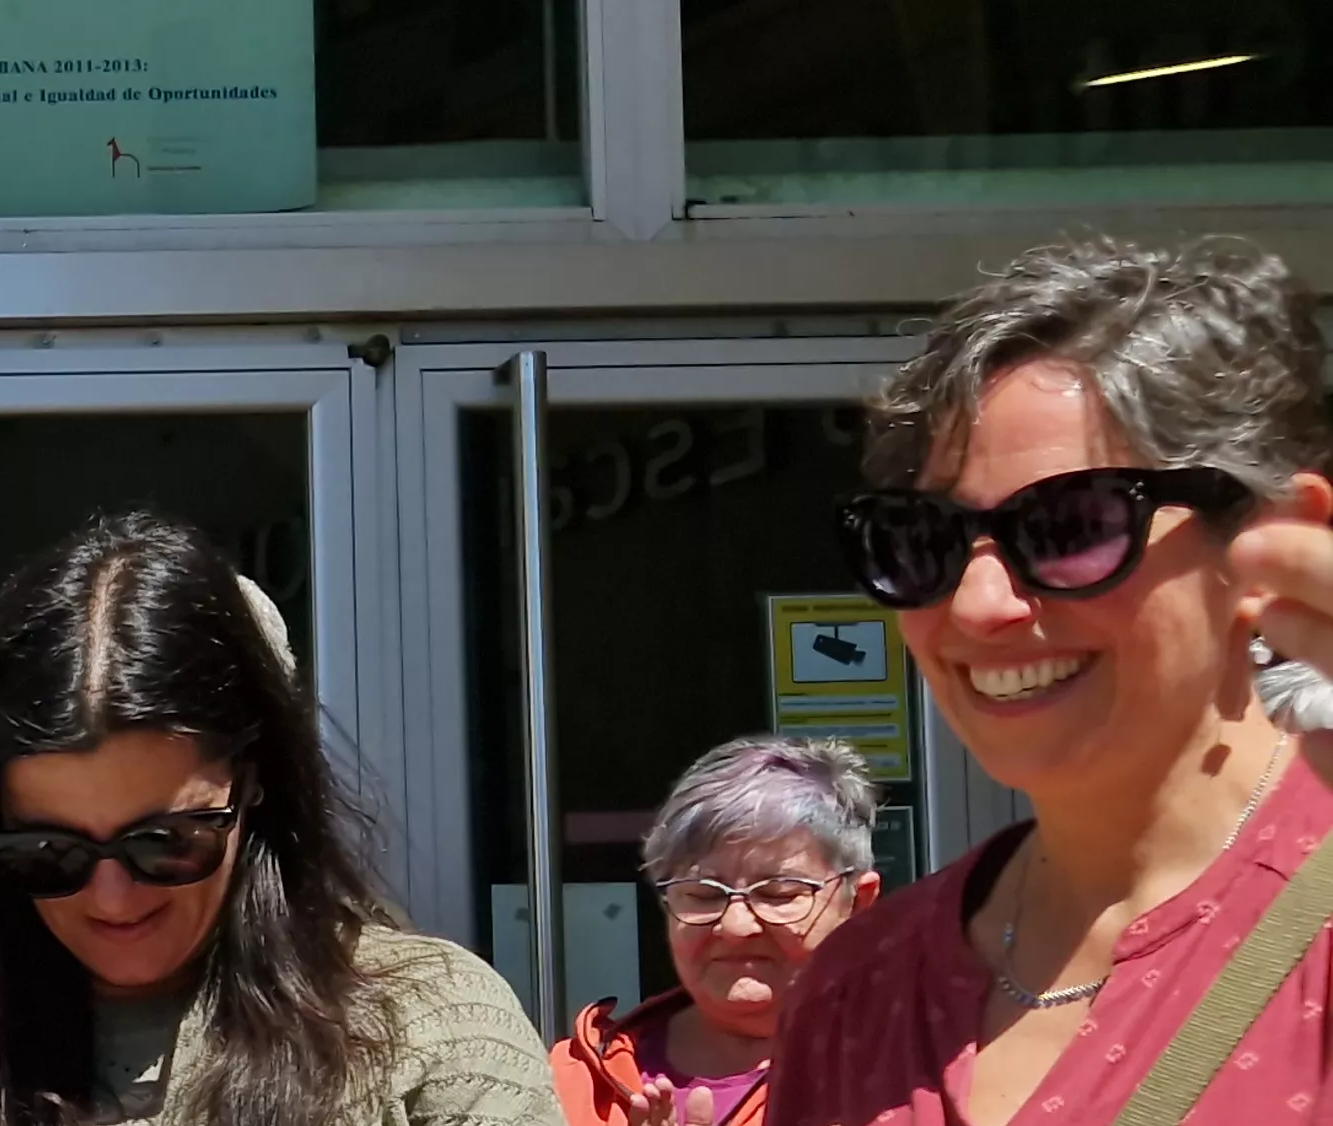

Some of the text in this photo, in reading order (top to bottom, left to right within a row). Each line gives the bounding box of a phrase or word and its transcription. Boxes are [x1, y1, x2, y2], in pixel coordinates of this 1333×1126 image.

[53, 58, 149, 74] 2011-2013:
[23, 92, 33, 102] e
[40, 86, 117, 105] Igualdad
[122, 86, 142, 102] de
[148, 85, 278, 105] Oportunidades
